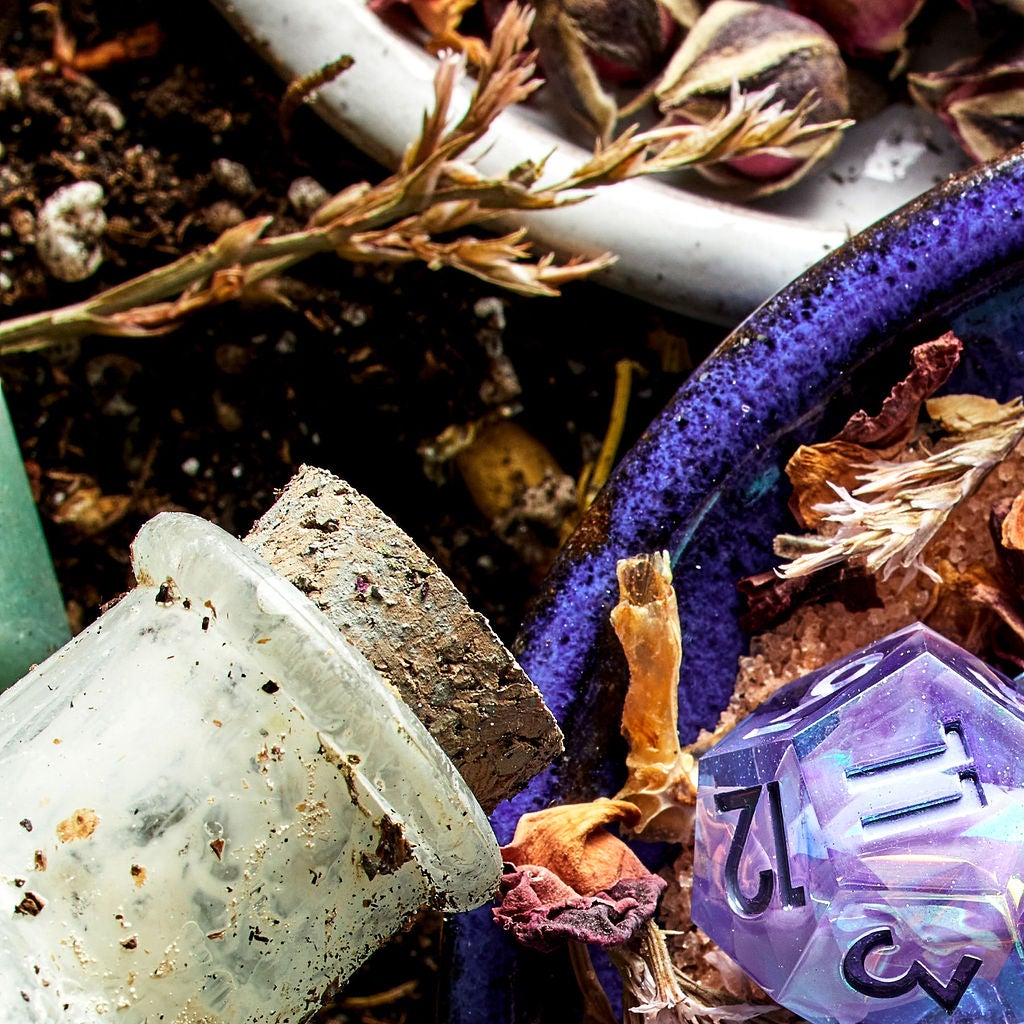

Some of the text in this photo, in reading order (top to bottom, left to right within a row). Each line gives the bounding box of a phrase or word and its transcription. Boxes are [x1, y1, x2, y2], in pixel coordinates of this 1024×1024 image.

[843, 717, 989, 838] 11
[713, 780, 807, 920] 12
[842, 926, 984, 1017] 3
